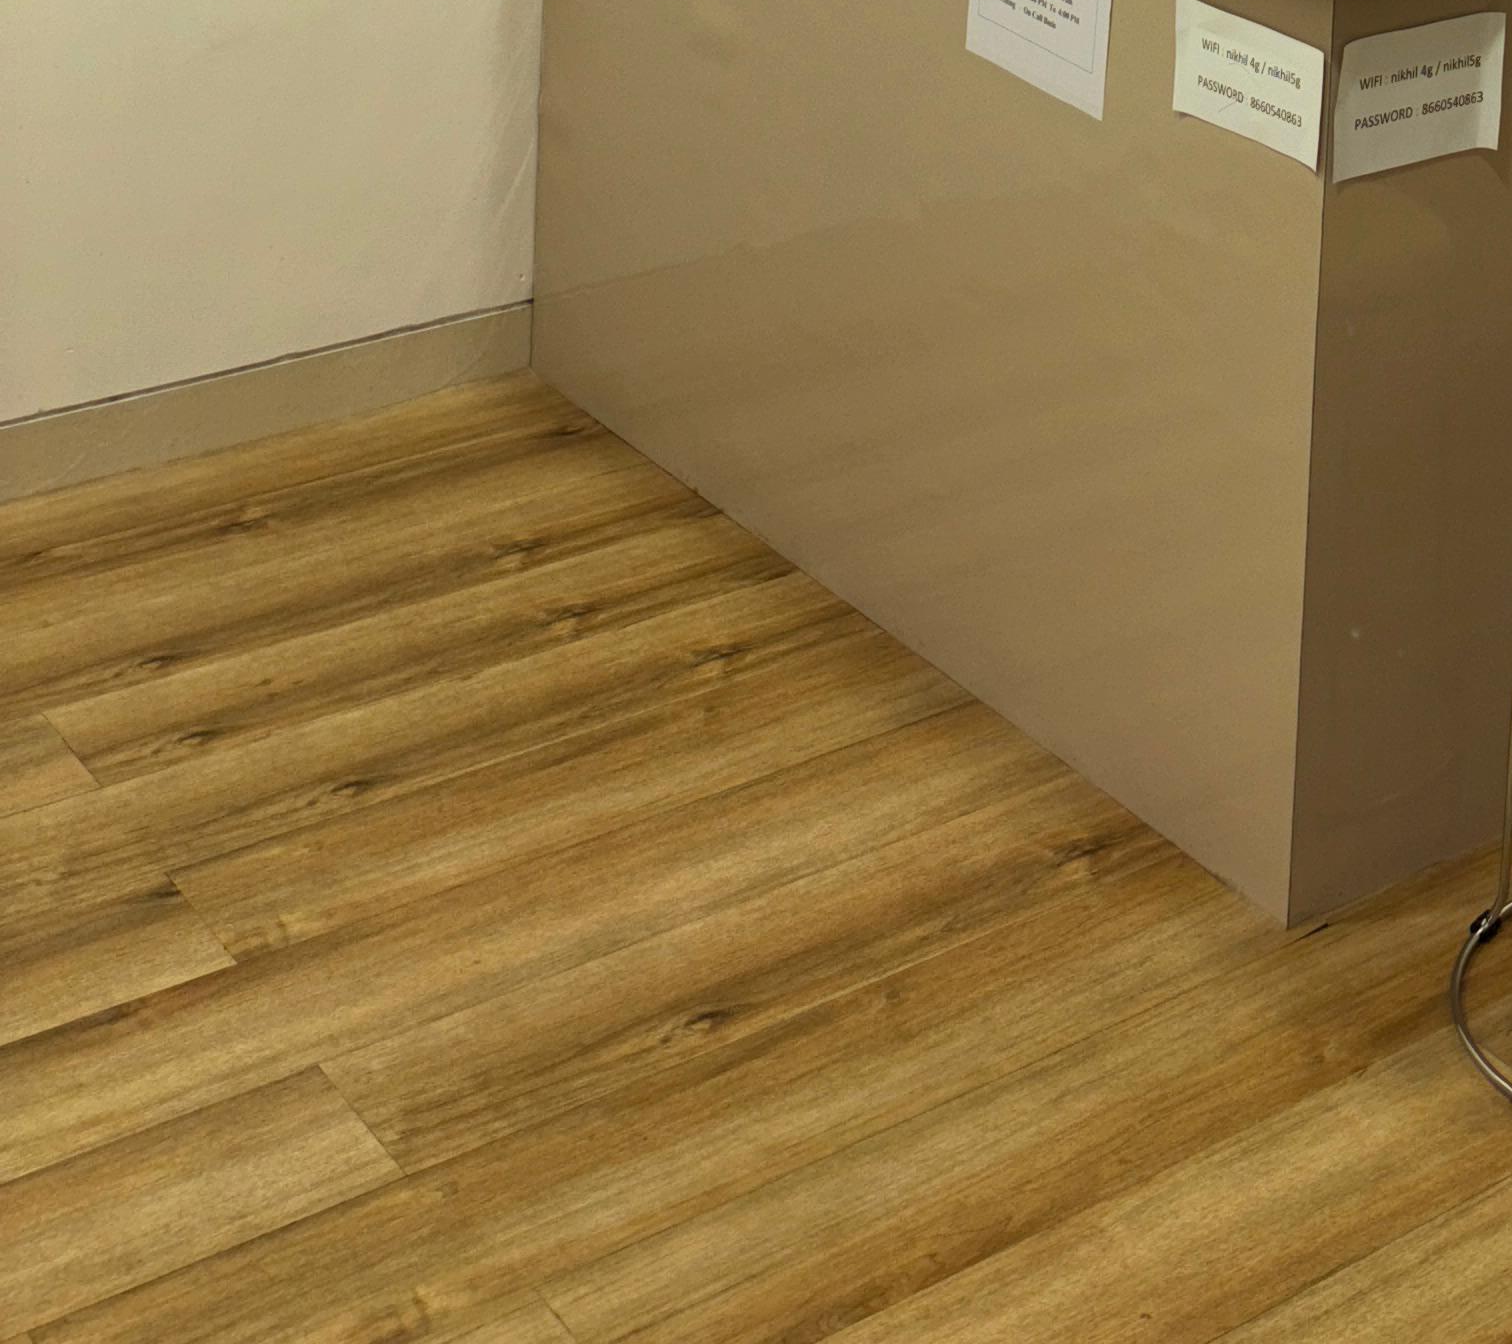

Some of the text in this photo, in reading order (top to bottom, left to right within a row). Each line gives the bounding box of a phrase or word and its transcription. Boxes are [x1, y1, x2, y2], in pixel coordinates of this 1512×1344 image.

[1201, 38, 1220, 55] WIFI
[1226, 49, 1249, 65] nikhil
[1249, 57, 1260, 74] 4g
[1260, 62, 1266, 75] /
[1267, 66, 1301, 90] nikhil5g
[1359, 75, 1382, 90] WIFI
[1391, 65, 1418, 83] nikhil
[1420, 65, 1433, 78] 4g
[1435, 60, 1441, 76] /
[1443, 54, 1482, 72] nikhil5g
[1197, 75, 1244, 103] PASSWORD
[1354, 107, 1413, 131] PASSWORD
[1421, 91, 1484, 115] 8660540863
